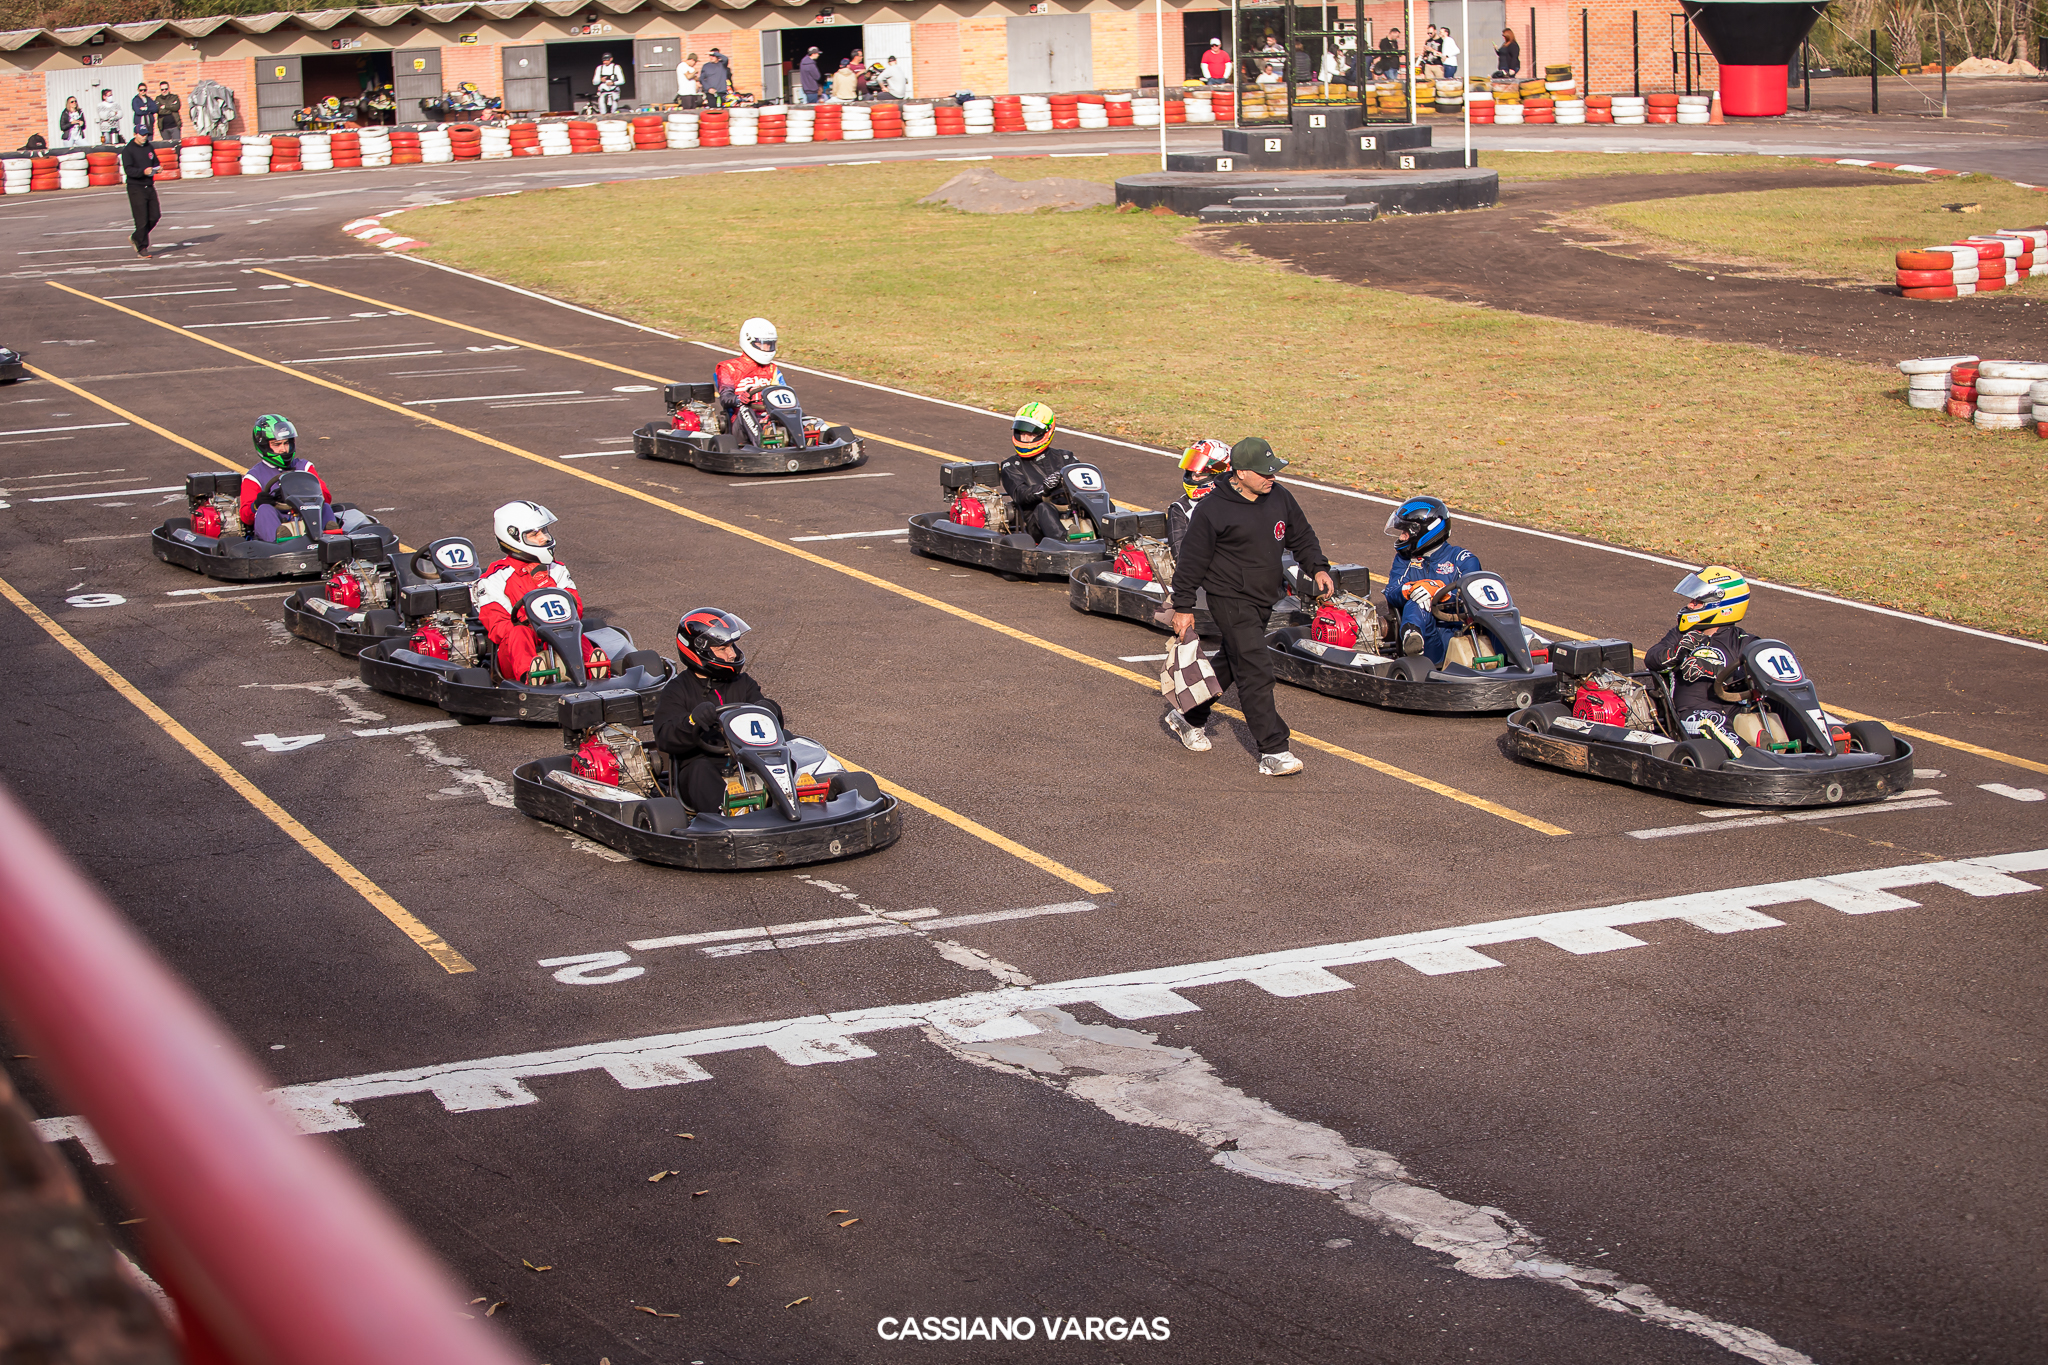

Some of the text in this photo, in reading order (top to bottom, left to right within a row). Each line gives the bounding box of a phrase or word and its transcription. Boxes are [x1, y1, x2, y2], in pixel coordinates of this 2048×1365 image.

[1268, 140, 1277, 150] 2
[1364, 138, 1373, 148] 3
[1219, 160, 1228, 169] 4
[1402, 157, 1411, 167] 5
[774, 394, 792, 405] 16
[1080, 473, 1094, 486] 5
[445, 548, 468, 564] 12
[1482, 585, 1500, 602] 6
[540, 600, 566, 618] 15
[1767, 655, 1796, 676] 14
[750, 720, 766, 739] 4
[537, 950, 646, 986] 2
